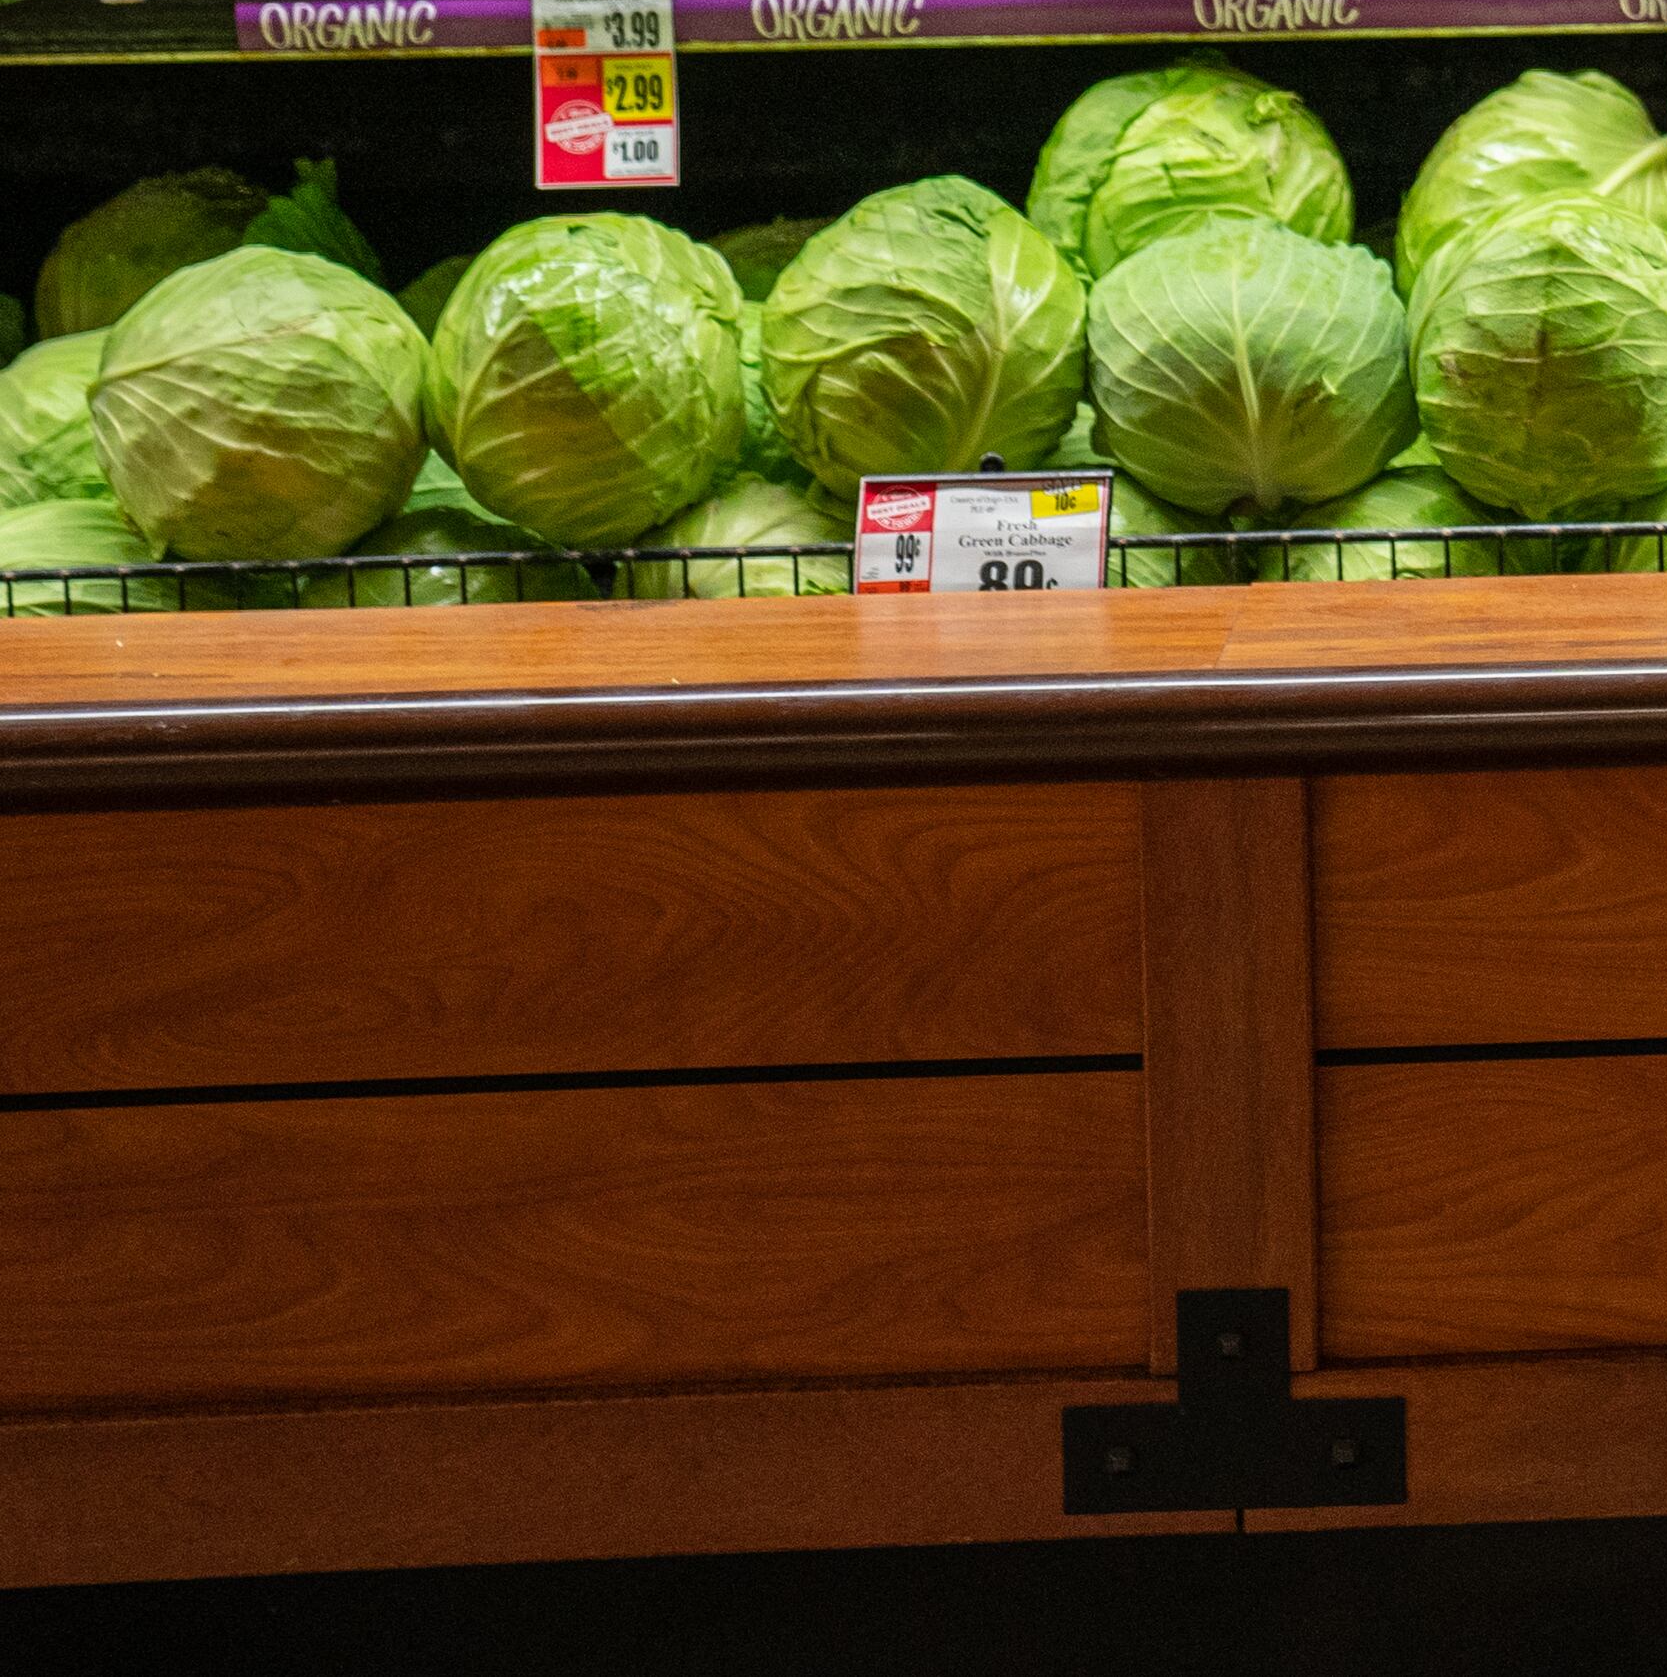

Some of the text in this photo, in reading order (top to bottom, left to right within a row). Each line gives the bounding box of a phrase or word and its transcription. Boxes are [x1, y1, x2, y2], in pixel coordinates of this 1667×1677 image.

[259, 0, 438, 51] ORGANIC
[604, 11, 660, 48] $3.99
[606, 74, 663, 111] $2.99
[613, 140, 659, 163] $1.00
[997, 520, 1039, 531] Fresh
[959, 534, 1073, 548] Green Cabbage
